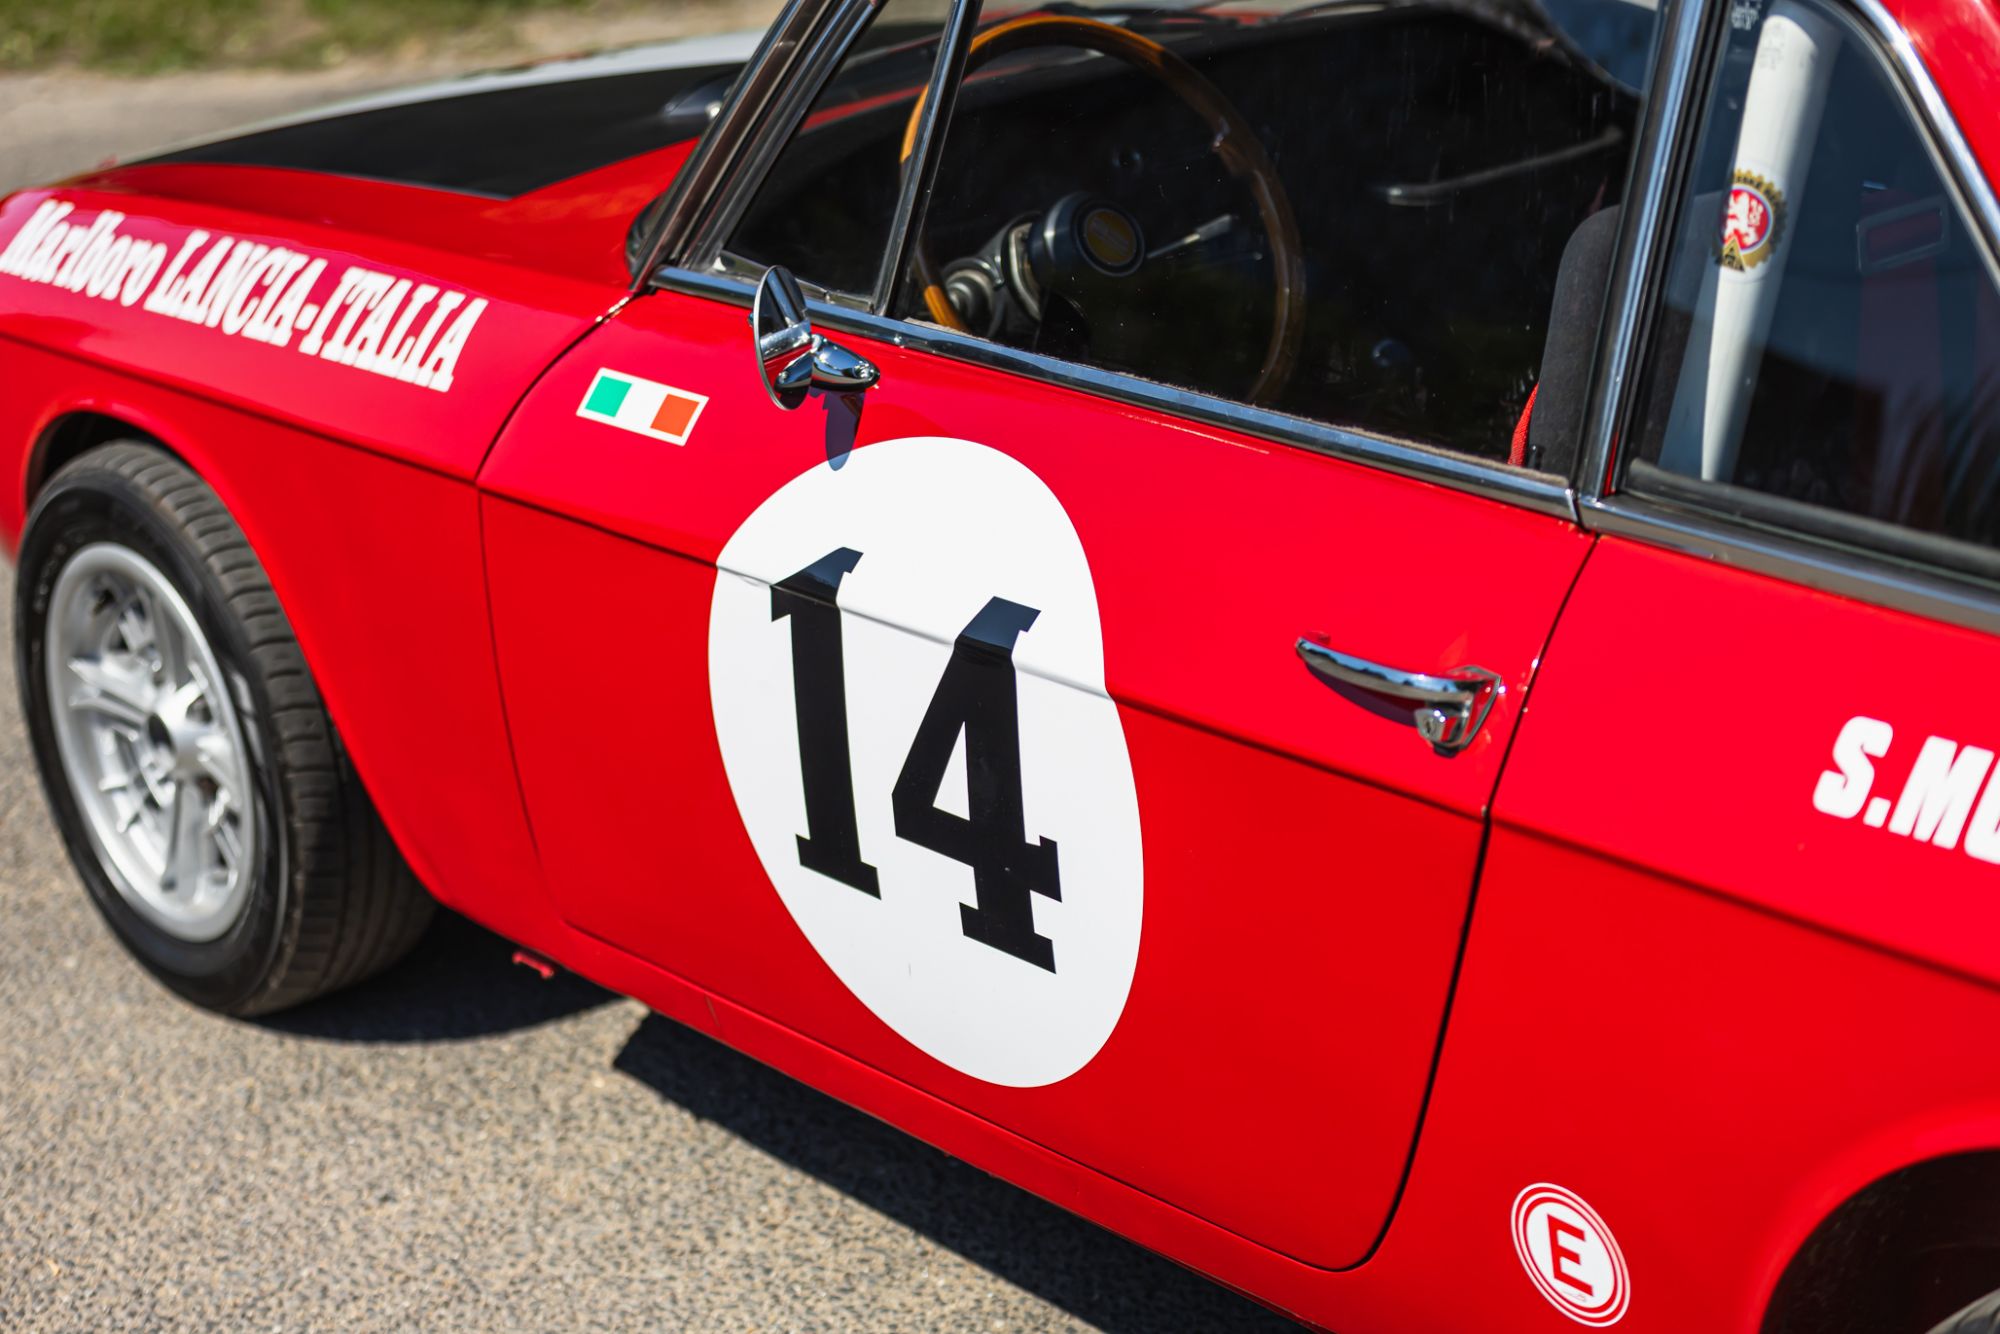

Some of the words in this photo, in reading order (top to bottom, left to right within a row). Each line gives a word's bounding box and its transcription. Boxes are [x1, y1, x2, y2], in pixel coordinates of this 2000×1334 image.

[0, 199, 167, 306] Marlboro
[144, 230, 489, 392] LANCIA-ITALIA
[770, 547, 1062, 974] 14
[1546, 1214, 1594, 1297] E
